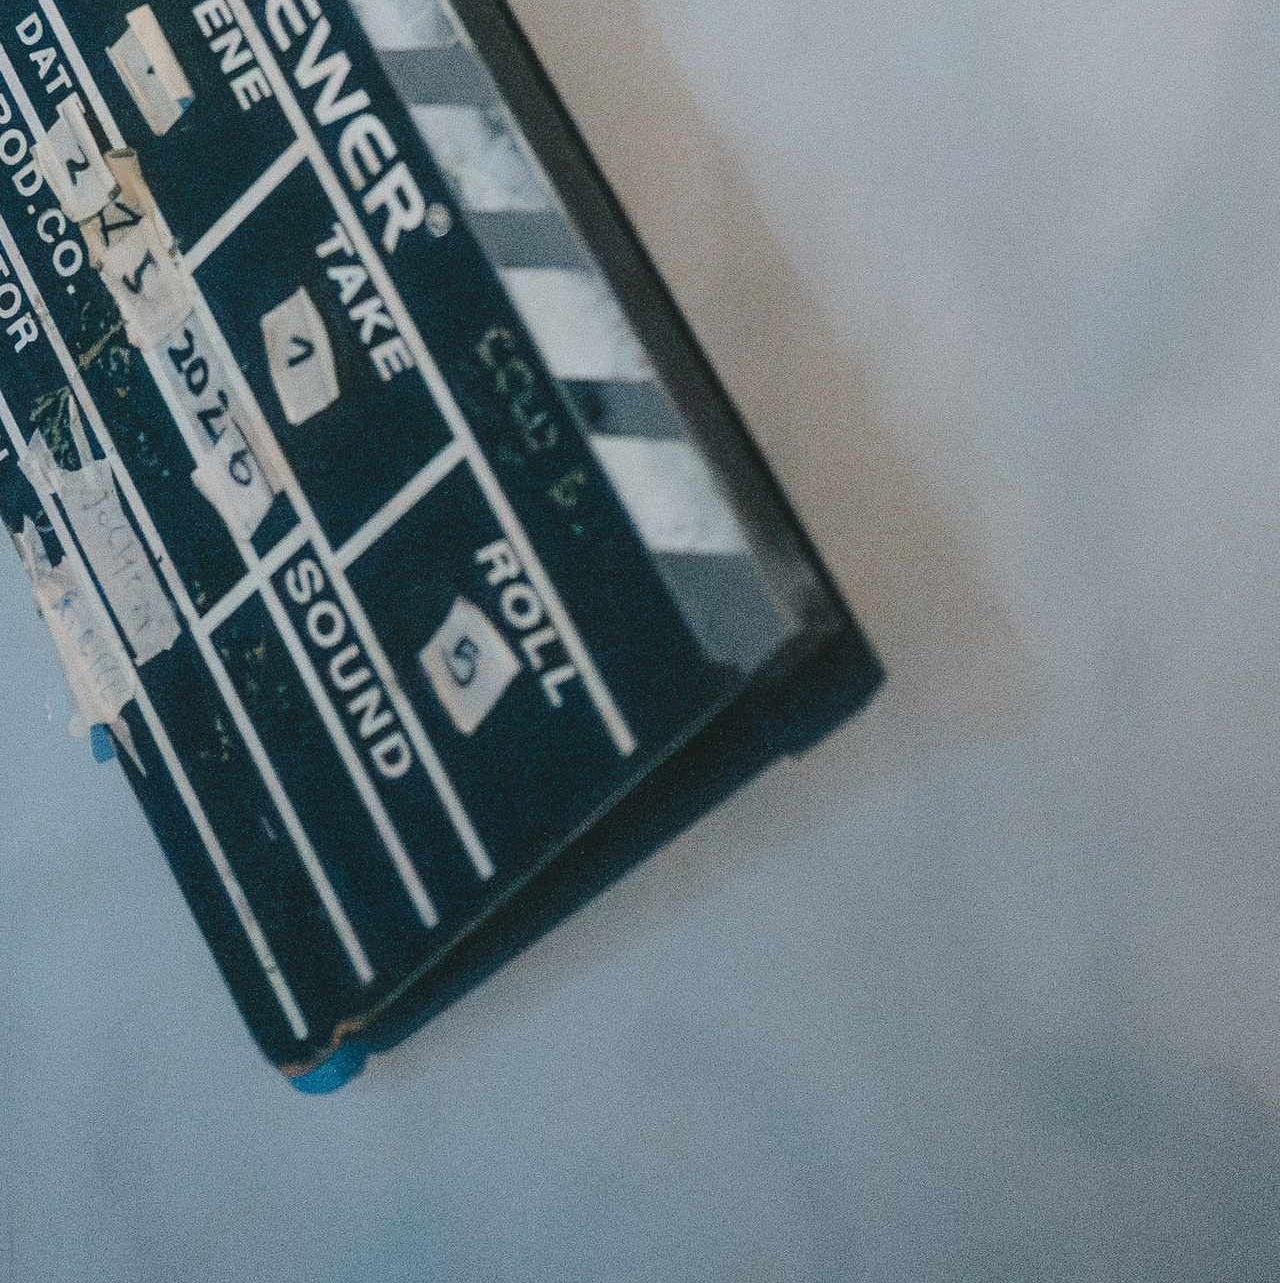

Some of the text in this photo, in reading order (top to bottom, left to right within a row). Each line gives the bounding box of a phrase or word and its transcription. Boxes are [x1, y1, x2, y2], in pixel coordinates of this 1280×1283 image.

[316, 222, 413, 381] TAKE
[286, 561, 410, 777] SOUND
[476, 540, 582, 706] ROLL
